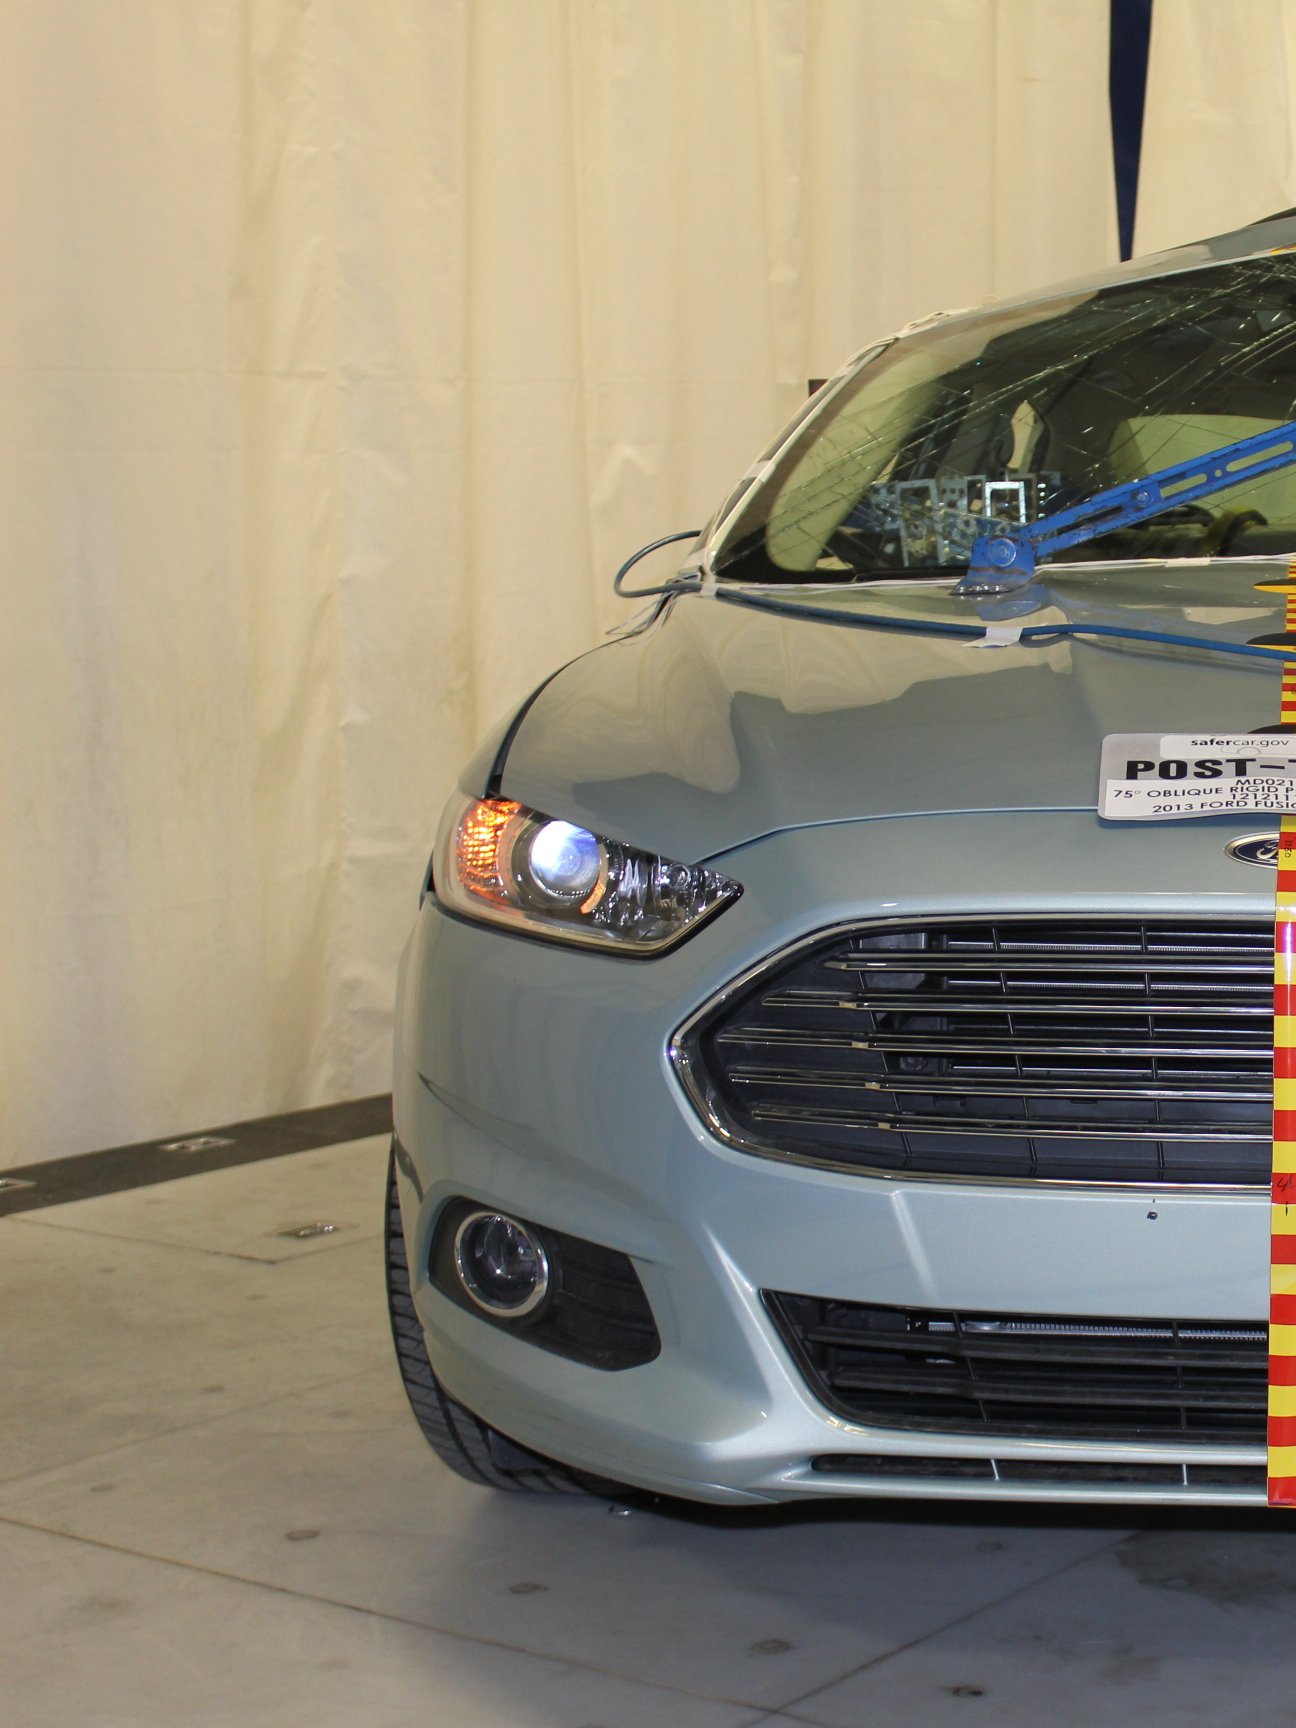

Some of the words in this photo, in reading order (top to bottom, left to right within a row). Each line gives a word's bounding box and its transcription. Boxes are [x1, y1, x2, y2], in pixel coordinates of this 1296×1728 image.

[1190, 737, 1290, 748] safercar.gov
[1146, 786, 1224, 798] OBLIQUE
[1229, 785, 1279, 794] RIGID
[1151, 803, 1194, 813] 2013
[1199, 800, 1249, 809] FORD
